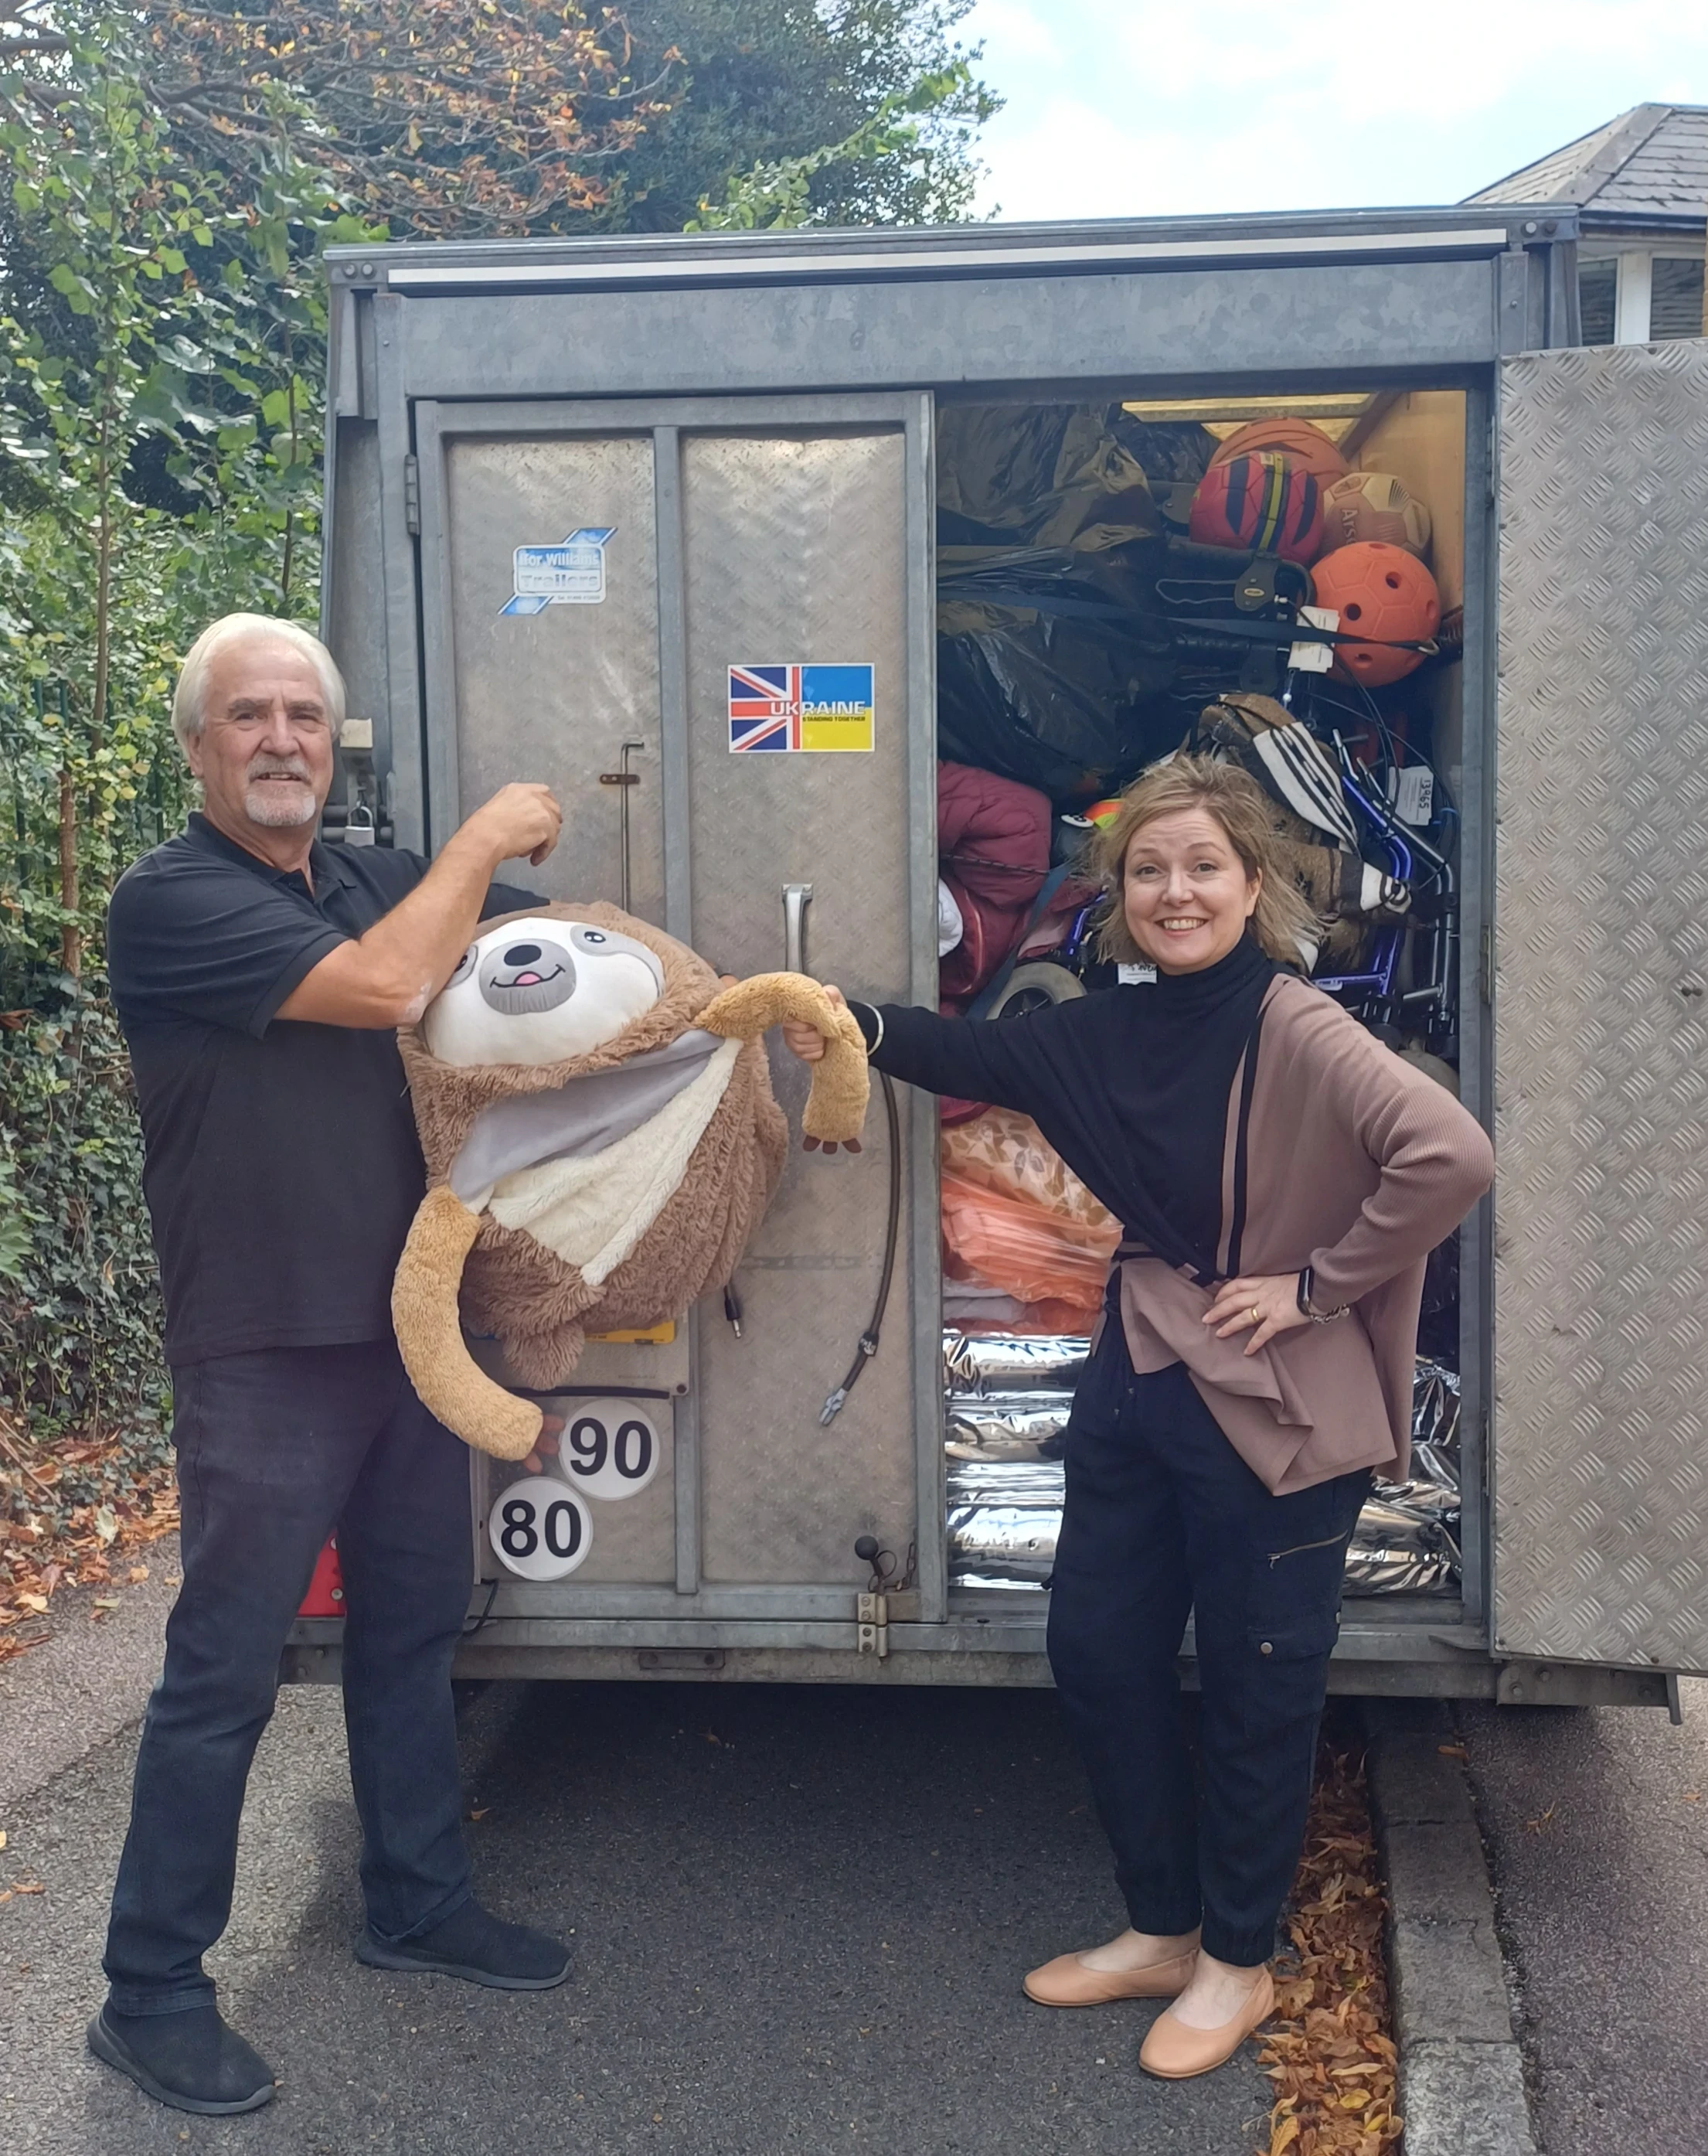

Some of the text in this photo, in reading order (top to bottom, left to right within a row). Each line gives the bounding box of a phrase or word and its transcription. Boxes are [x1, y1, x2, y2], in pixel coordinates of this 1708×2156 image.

[546, 551, 601, 566] Williams
[520, 573, 598, 588] Trailers
[770, 700, 866, 716] UKRAINE
[1419, 779, 1431, 809] 13965
[570, 1417, 652, 1480] 90
[500, 1499, 582, 1558] 80
